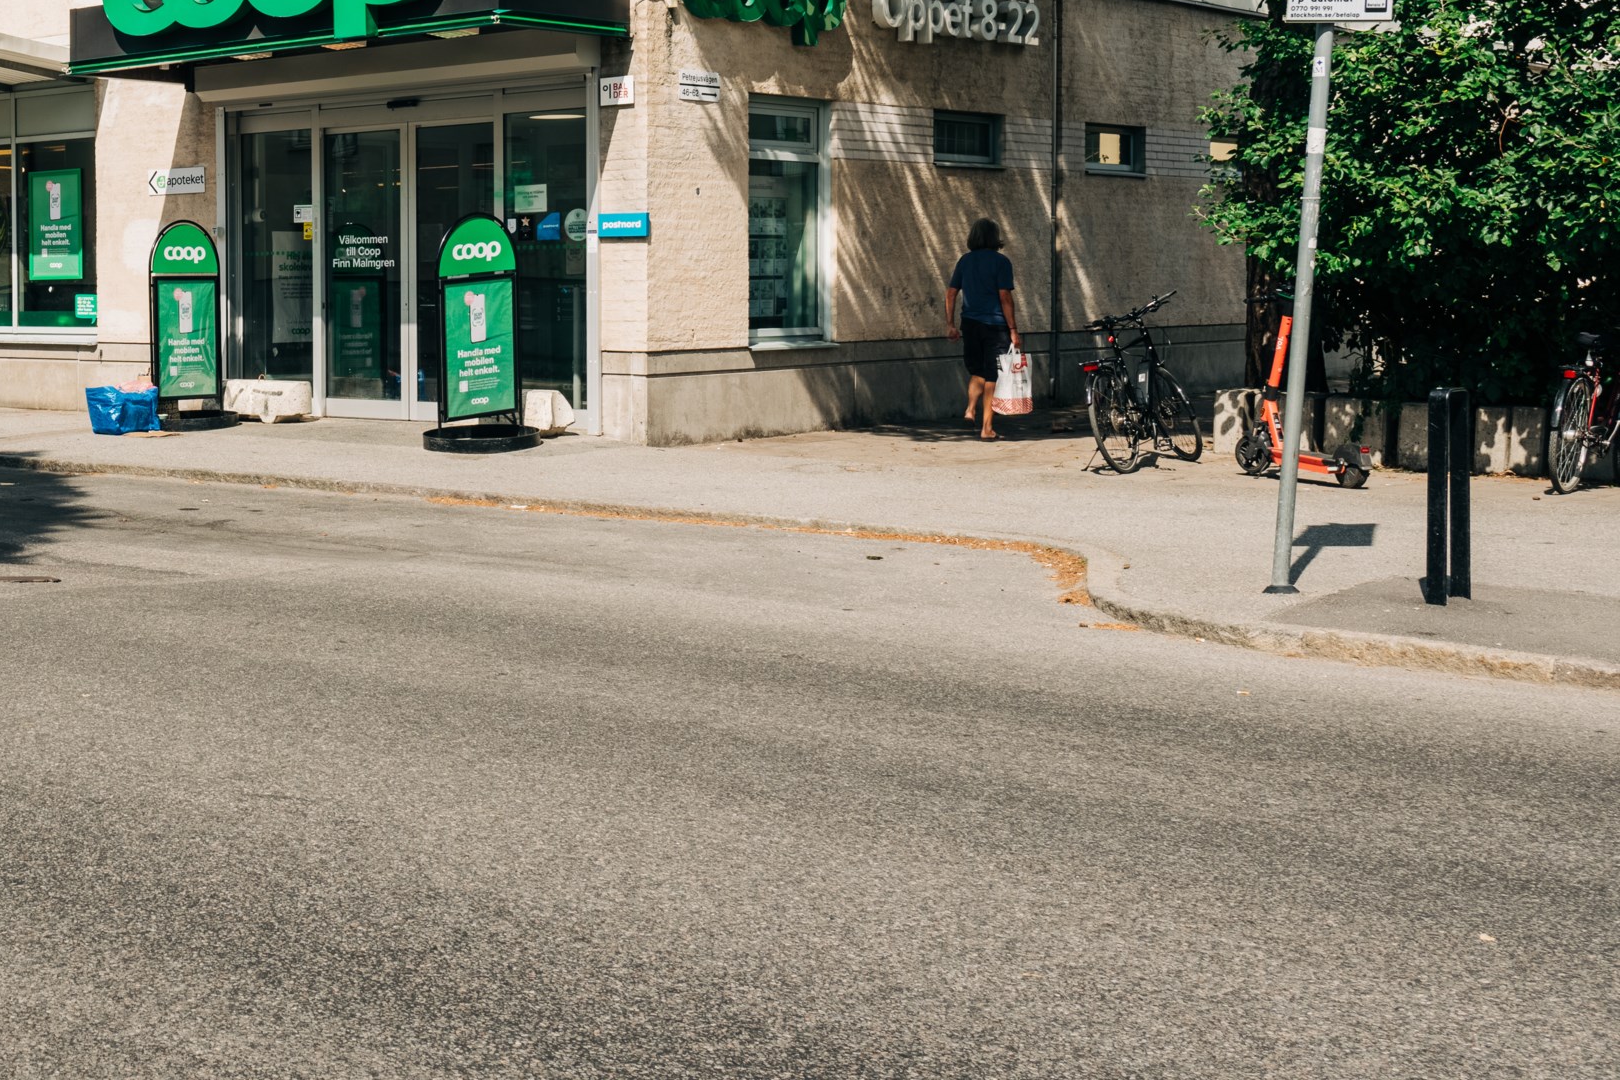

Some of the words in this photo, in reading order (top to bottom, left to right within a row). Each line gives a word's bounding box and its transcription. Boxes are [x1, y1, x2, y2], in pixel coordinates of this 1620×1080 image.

[613, 91, 628, 99] DER
[167, 175, 204, 189] apoteket
[40, 224, 59, 232] Handla
[59, 223, 72, 231] med
[602, 220, 642, 230] postnord
[338, 235, 388, 245] Välkommen
[164, 246, 206, 264] coop
[346, 247, 356, 256] till
[358, 247, 381, 257] Coop
[452, 240, 502, 262] coop
[332, 259, 350, 268] Finn
[356, 258, 395, 270] Malmgren
[291, 326, 311, 336] coop
[168, 338, 191, 346] Handla
[191, 337, 205, 345] med
[174, 346, 200, 354] mobilen
[457, 348, 483, 359] Handla
[484, 344, 502, 355] med
[169, 355, 182, 363] helt
[464, 356, 495, 368] mobilen
[459, 367, 474, 378] helt
[474, 364, 500, 376] enkelt.
[179, 381, 195, 389] coop
[471, 396, 490, 405] coop
